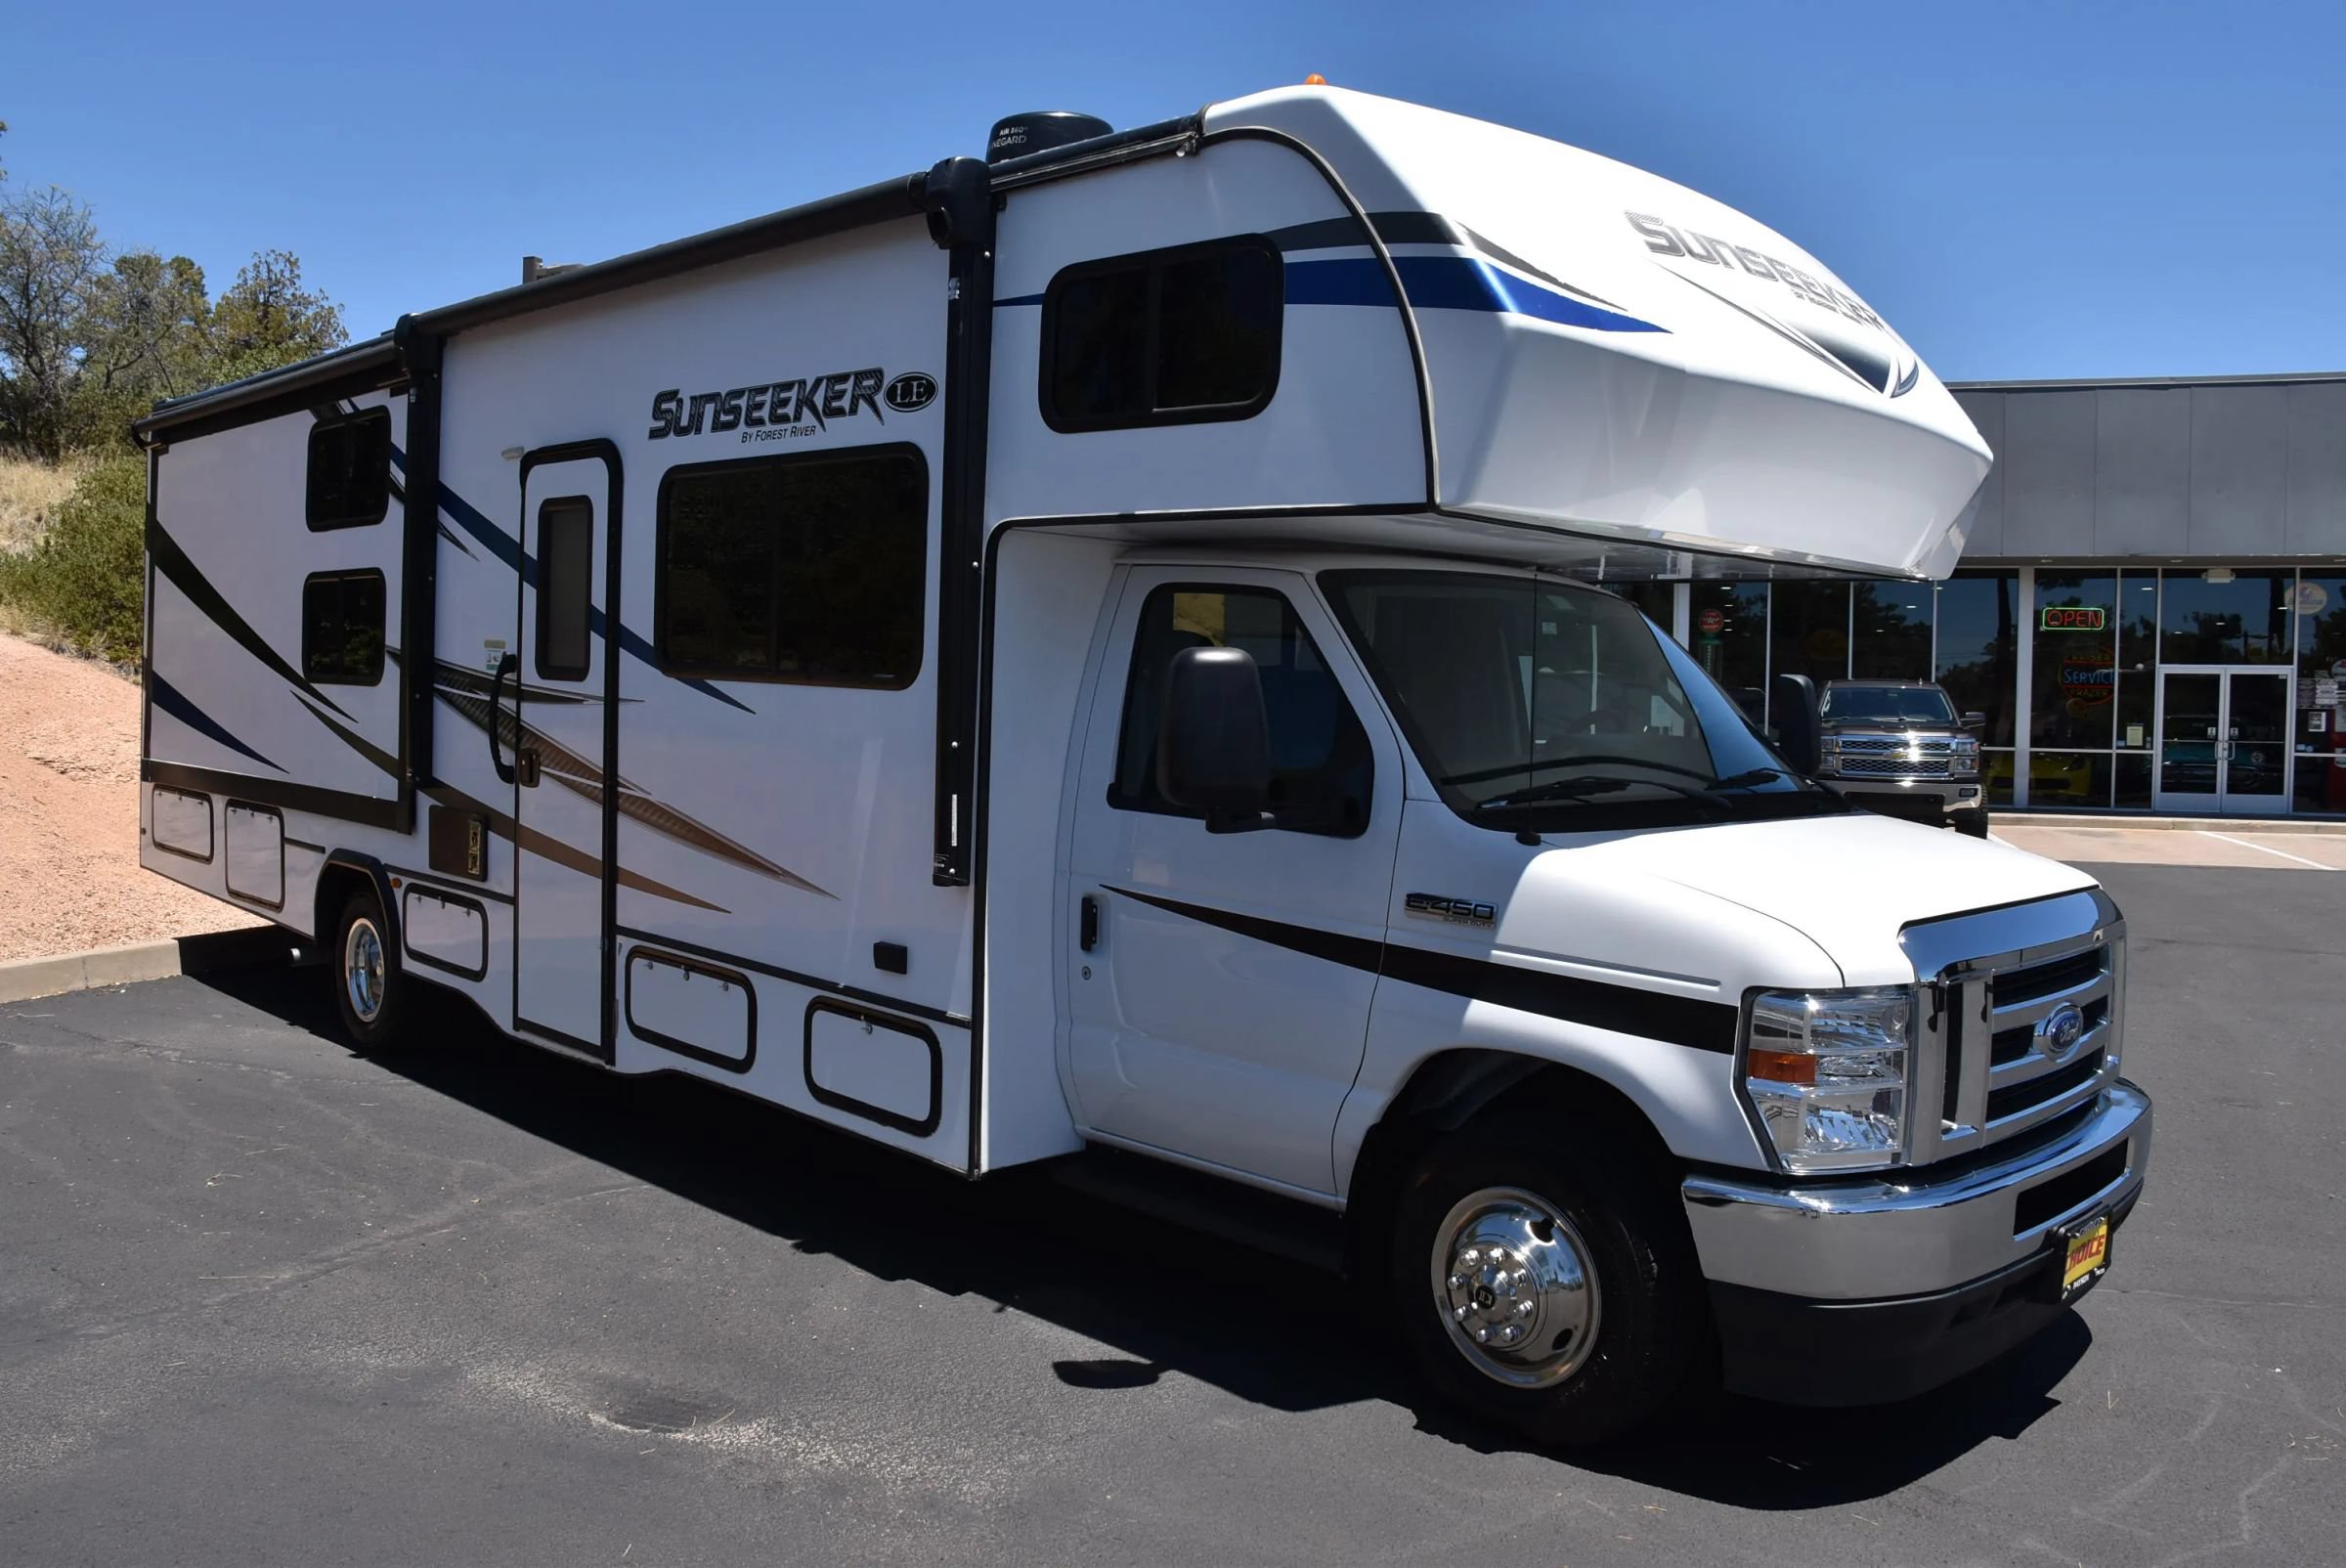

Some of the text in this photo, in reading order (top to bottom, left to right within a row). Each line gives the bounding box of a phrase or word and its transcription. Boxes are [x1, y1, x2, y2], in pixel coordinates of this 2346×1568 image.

[1624, 209, 1885, 331] SUNSEEKER
[648, 367, 929, 440] SUNSEEKER LE
[741, 425, 816, 443] BY FOREST RIVER
[2047, 609, 2101, 627] OPEN
[2059, 1019, 2080, 1043] Ford
